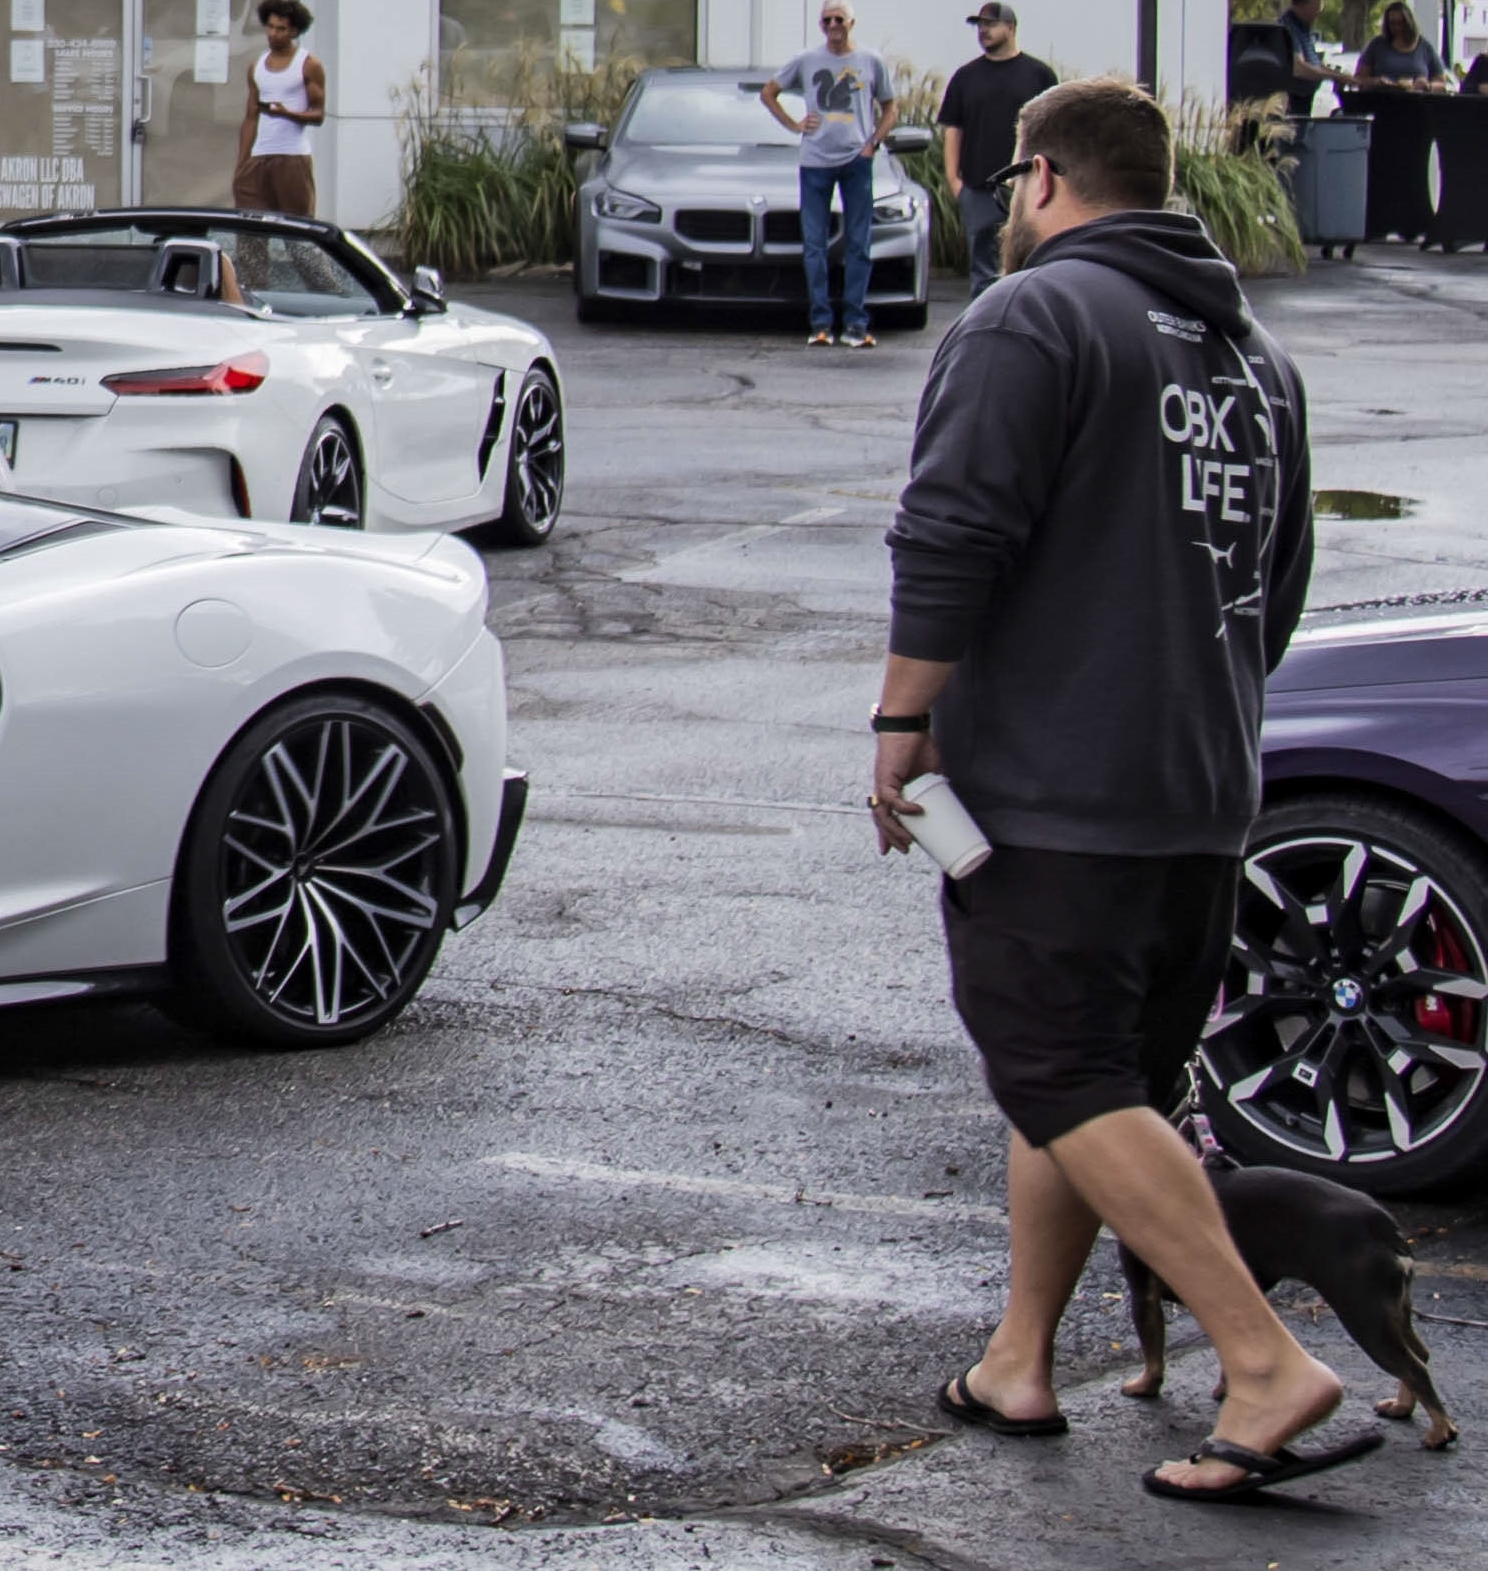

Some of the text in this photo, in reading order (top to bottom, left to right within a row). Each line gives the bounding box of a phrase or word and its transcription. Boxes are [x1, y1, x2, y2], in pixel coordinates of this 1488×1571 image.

[0, 156, 38, 181] AKRON
[40, 156, 59, 182] LLC
[61, 157, 84, 182] DBA
[41, 184, 55, 209] OF
[57, 184, 95, 209] AKRON
[1160, 383, 1236, 452] OBX
